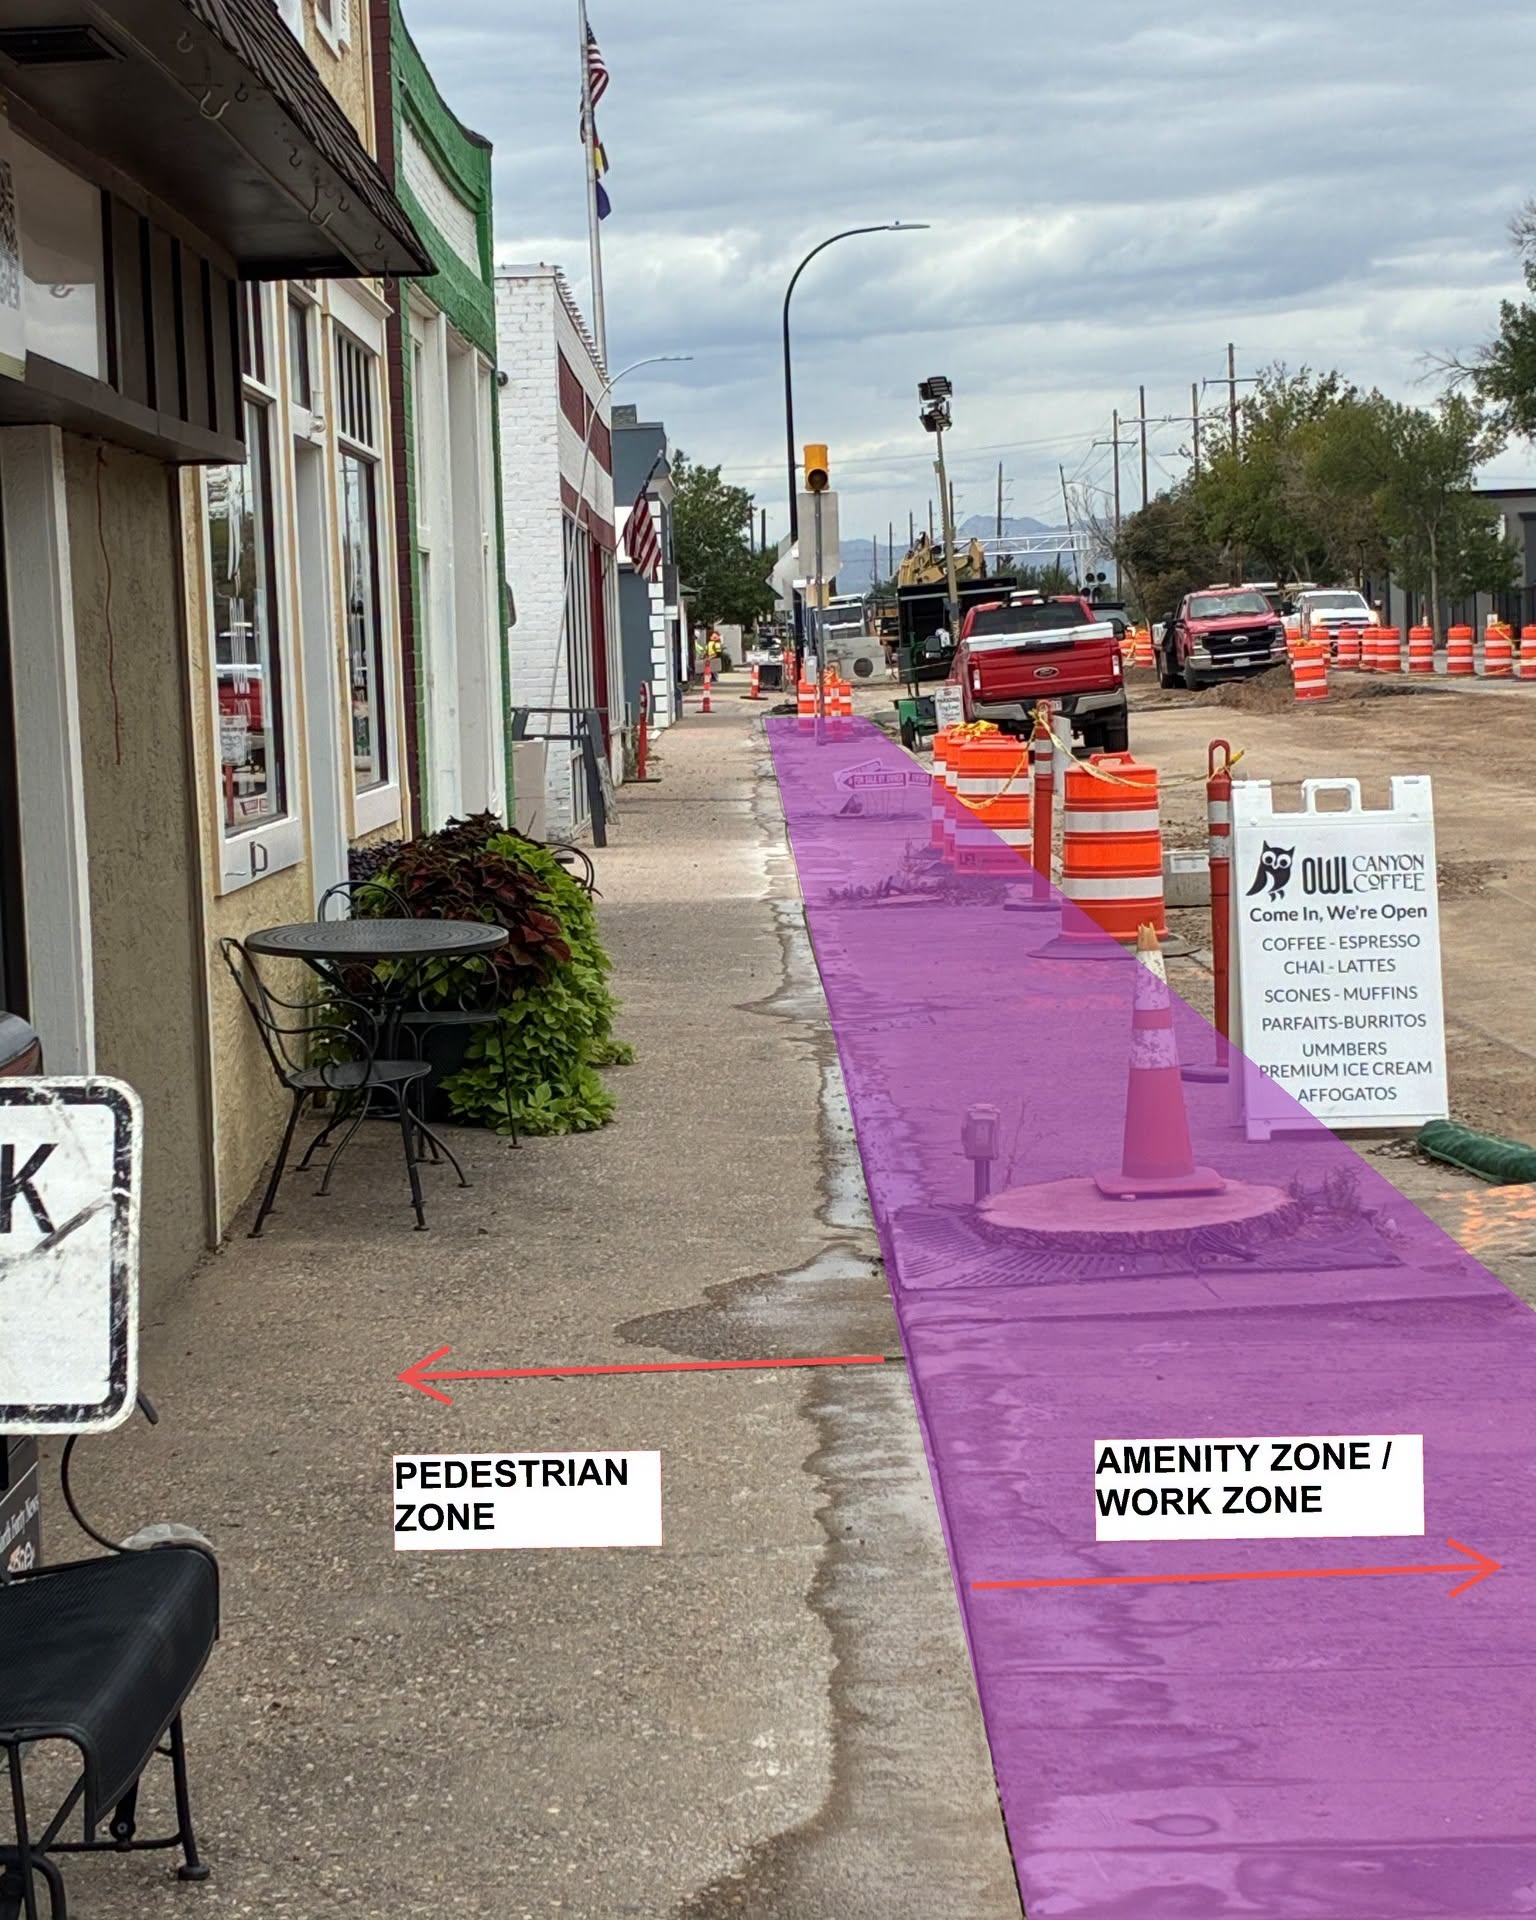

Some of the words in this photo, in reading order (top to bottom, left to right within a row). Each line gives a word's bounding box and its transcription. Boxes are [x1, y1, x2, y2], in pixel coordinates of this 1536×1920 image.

[1302, 856, 1353, 895] OWL
[1352, 854, 1425, 872] CANYON
[1353, 873, 1426, 893] COFFEE
[1250, 908, 1298, 922] Come
[1303, 907, 1323, 922] In,
[1327, 905, 1377, 920] We're
[1381, 904, 1427, 921] Open
[1262, 937, 1326, 951] COFFEE
[1339, 934, 1420, 949] ESPRESSO
[1284, 960, 1324, 975] CHAI
[1338, 958, 1396, 973] LATTES
[1265, 988, 1330, 1003] SCONES
[1344, 986, 1418, 1000] MUFFINS
[1303, 1042, 1387, 1057] UMMBERS
[1259, 1063, 1339, 1079] PREMIUM
[1343, 1063, 1369, 1076] ICE
[1373, 1061, 1432, 1075] CREAM
[1298, 1086, 1398, 1102] AFFOGATOS
